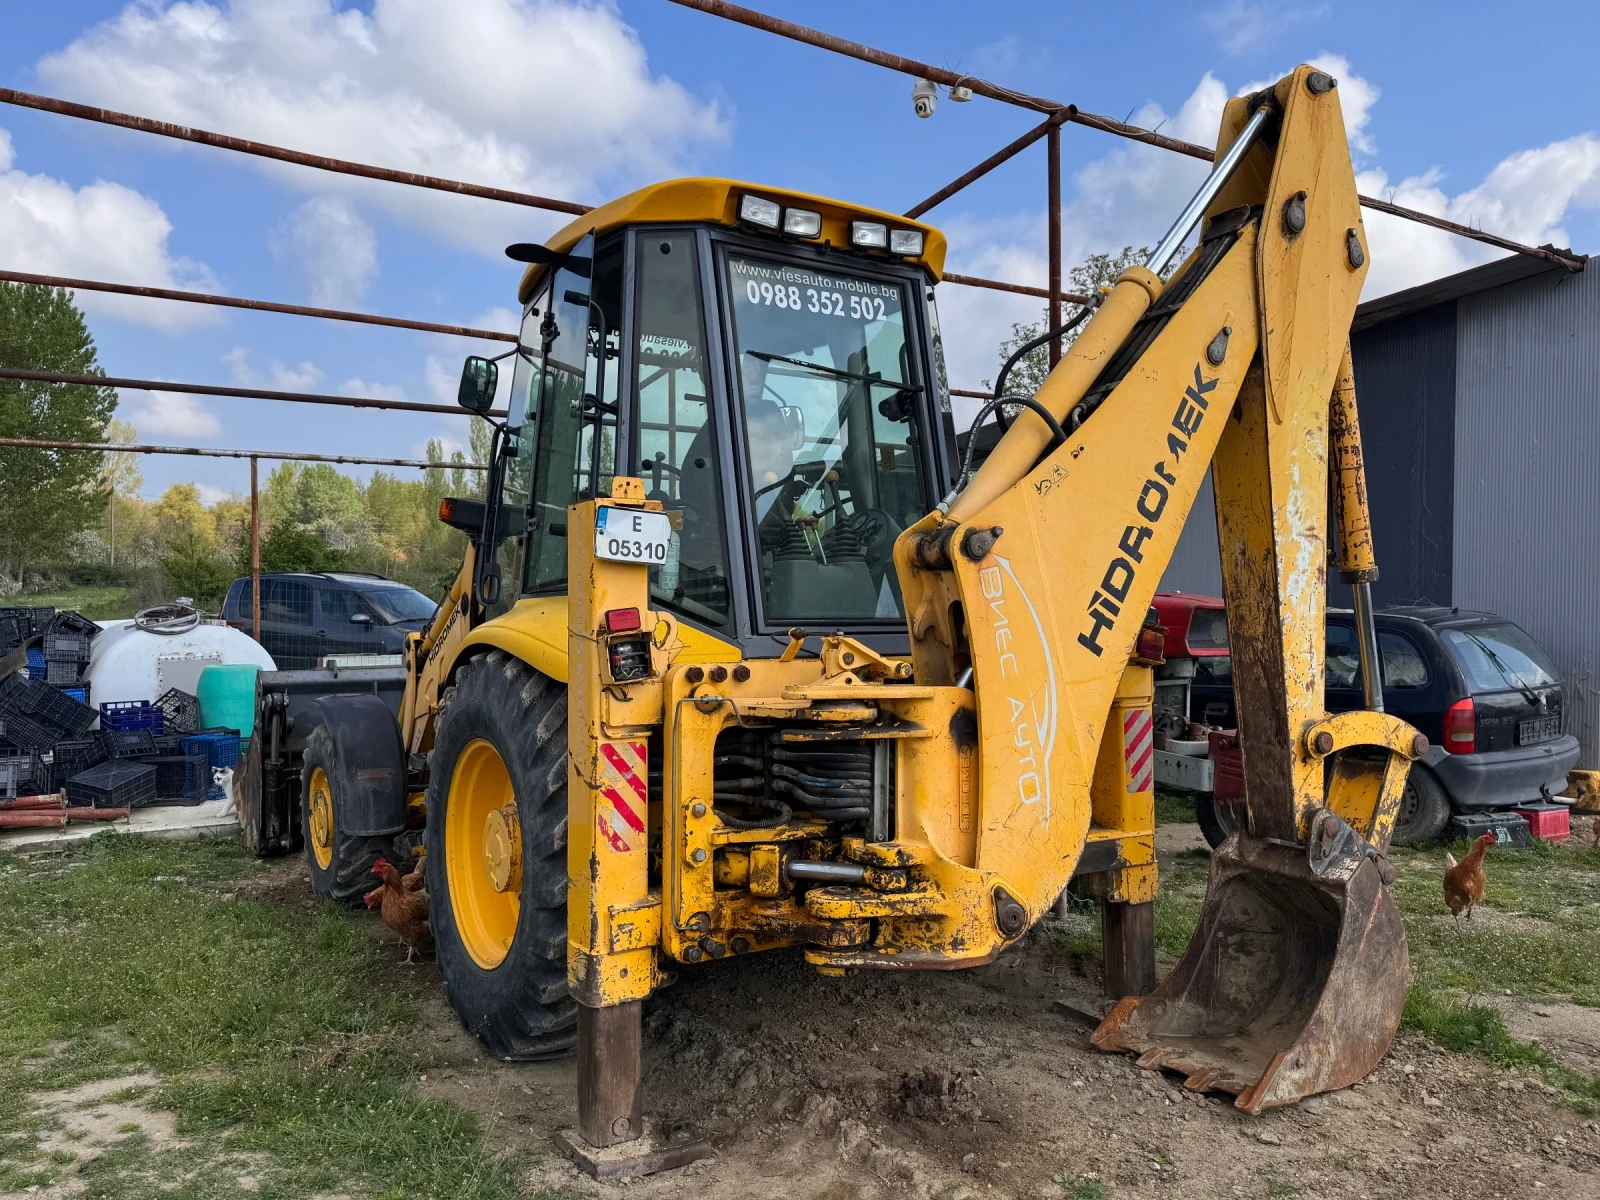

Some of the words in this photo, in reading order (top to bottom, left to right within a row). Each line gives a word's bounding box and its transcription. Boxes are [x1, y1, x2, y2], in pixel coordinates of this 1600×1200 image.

[734, 263, 898, 300] www.viesauto.mobile.bg
[746, 279, 802, 311] 0988
[807, 288, 846, 317] 352
[850, 296, 887, 321] 502
[632, 515, 642, 533] E
[608, 538, 666, 561] 05310
